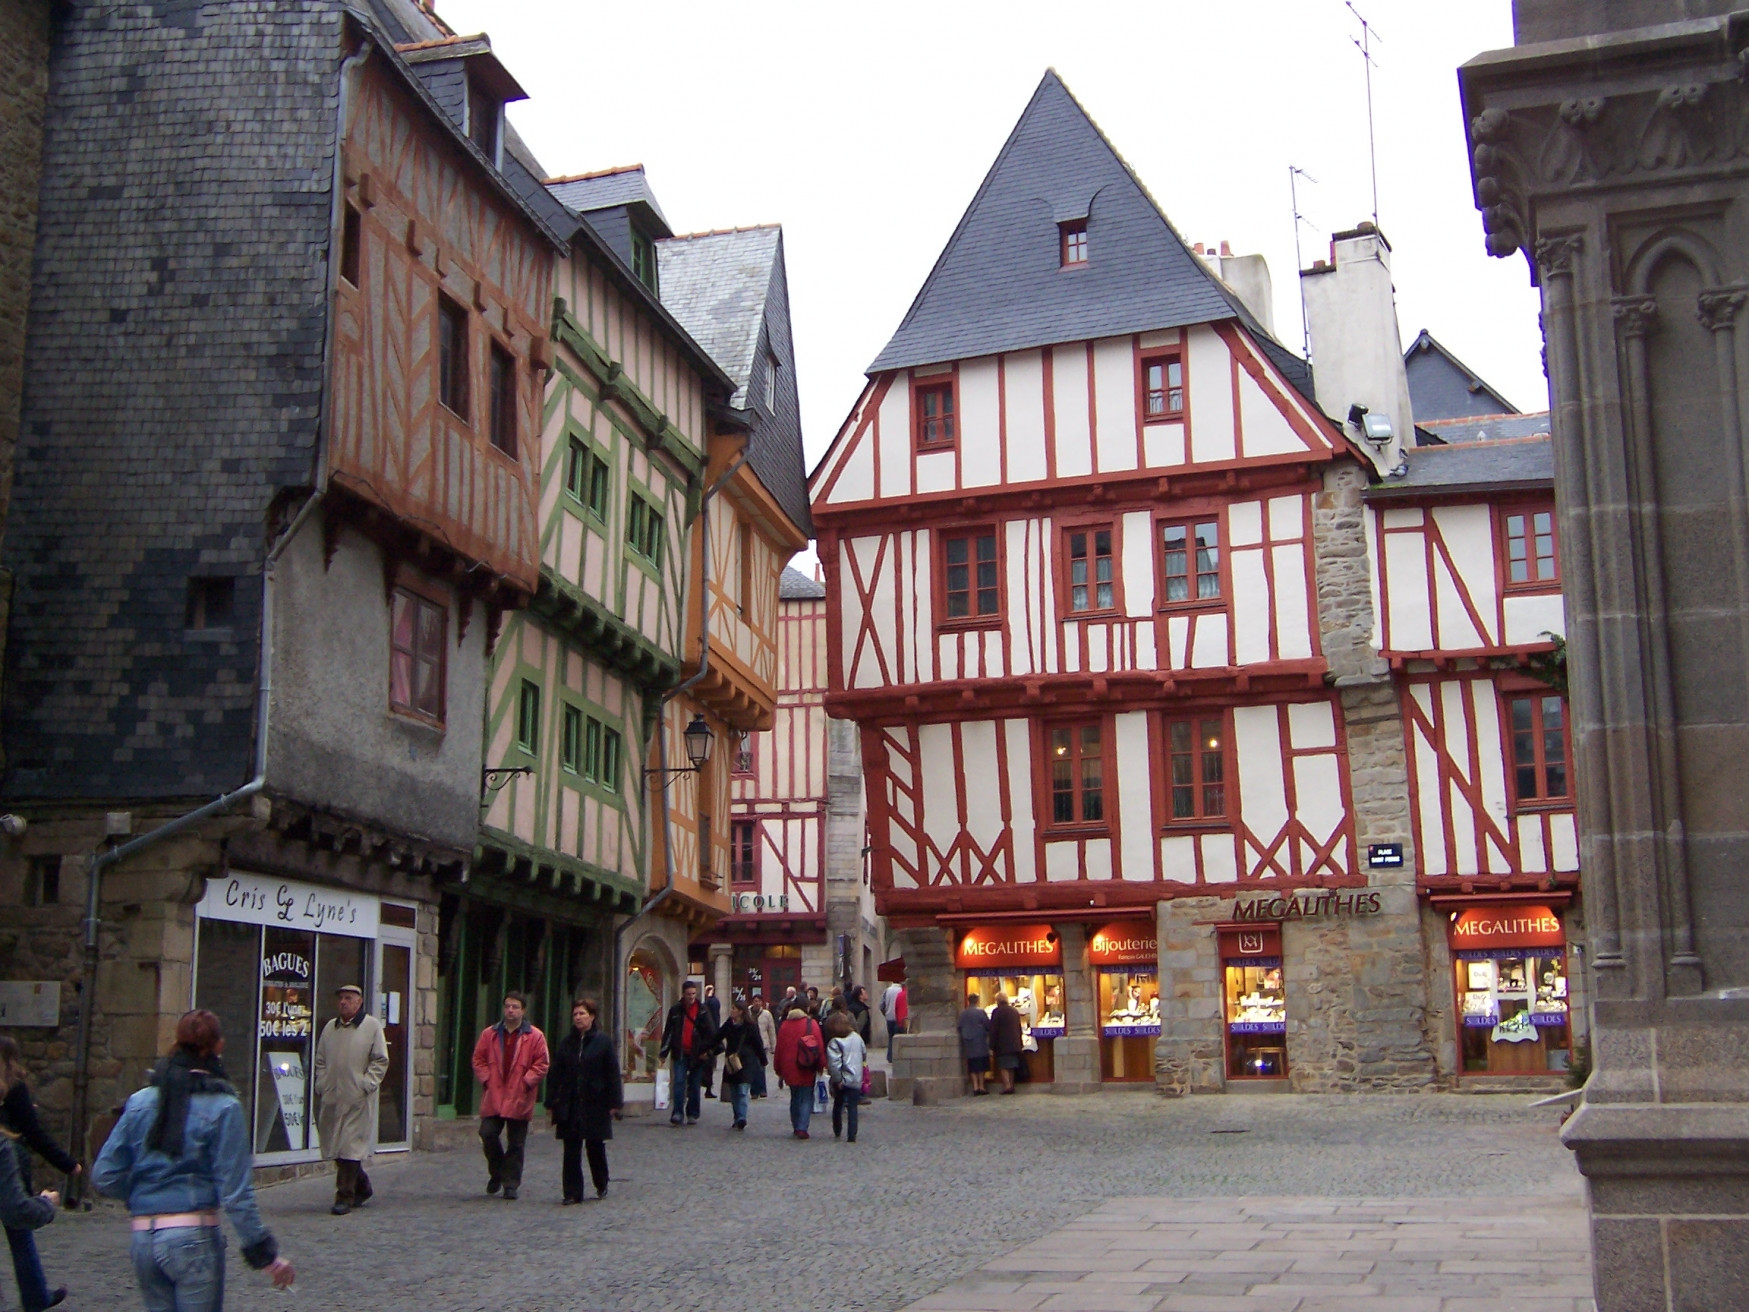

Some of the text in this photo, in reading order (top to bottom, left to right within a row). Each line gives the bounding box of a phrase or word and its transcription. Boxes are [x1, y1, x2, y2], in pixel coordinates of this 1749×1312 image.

[226, 880, 266, 910] Cris
[303, 893, 357, 928] Lyne's
[1231, 892, 1381, 921] MEGALITHES
[1454, 917, 1560, 936] MEGALITHES
[963, 940, 1054, 956] MEGALITHES
[1092, 936, 1158, 956] Bijouterie
[262, 952, 310, 978] BAGUES
[265, 1001, 281, 1015] 30€
[260, 1020, 308, 1037] 50€ les 2
